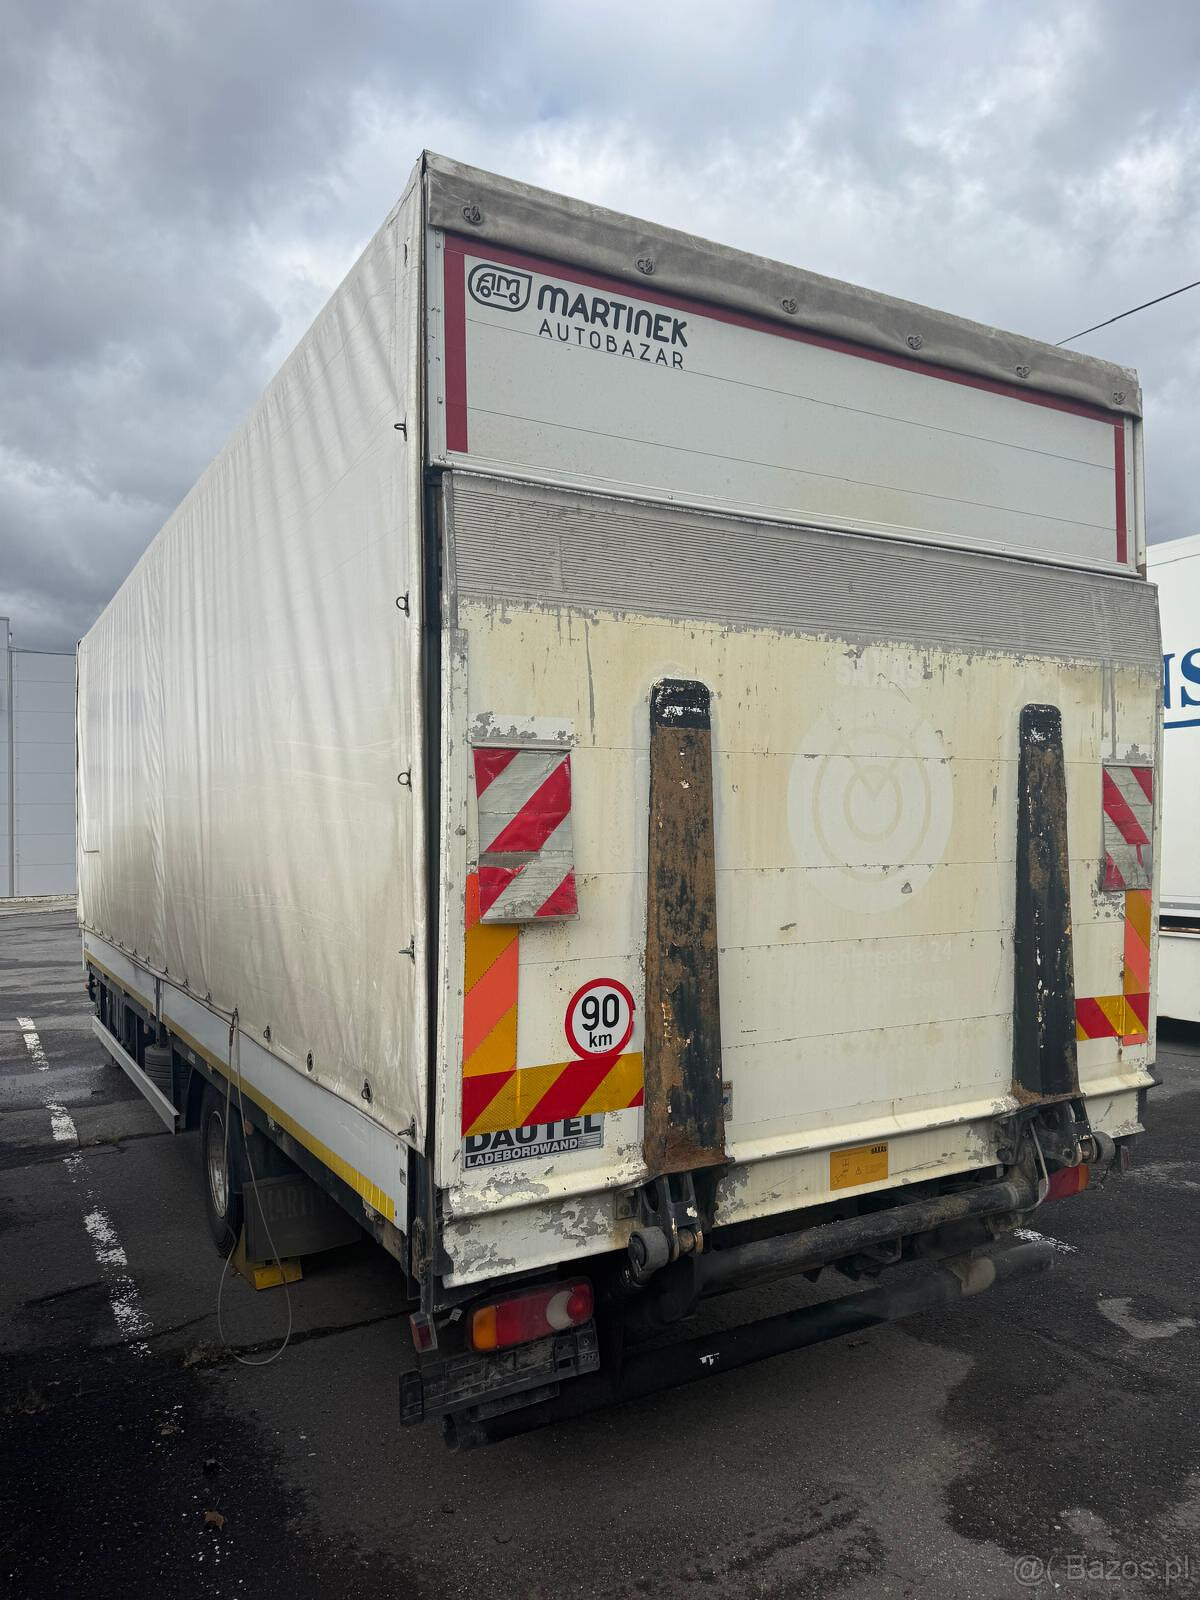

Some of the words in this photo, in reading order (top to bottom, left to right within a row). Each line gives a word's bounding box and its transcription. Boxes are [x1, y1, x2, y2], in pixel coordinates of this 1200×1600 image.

[537, 284, 688, 347] MARTINEK
[538, 318, 684, 370] AUTOBAZAR
[581, 993, 620, 1031] 90
[589, 1031, 612, 1048] km
[466, 1138, 579, 1168] LADEBORDWAND
